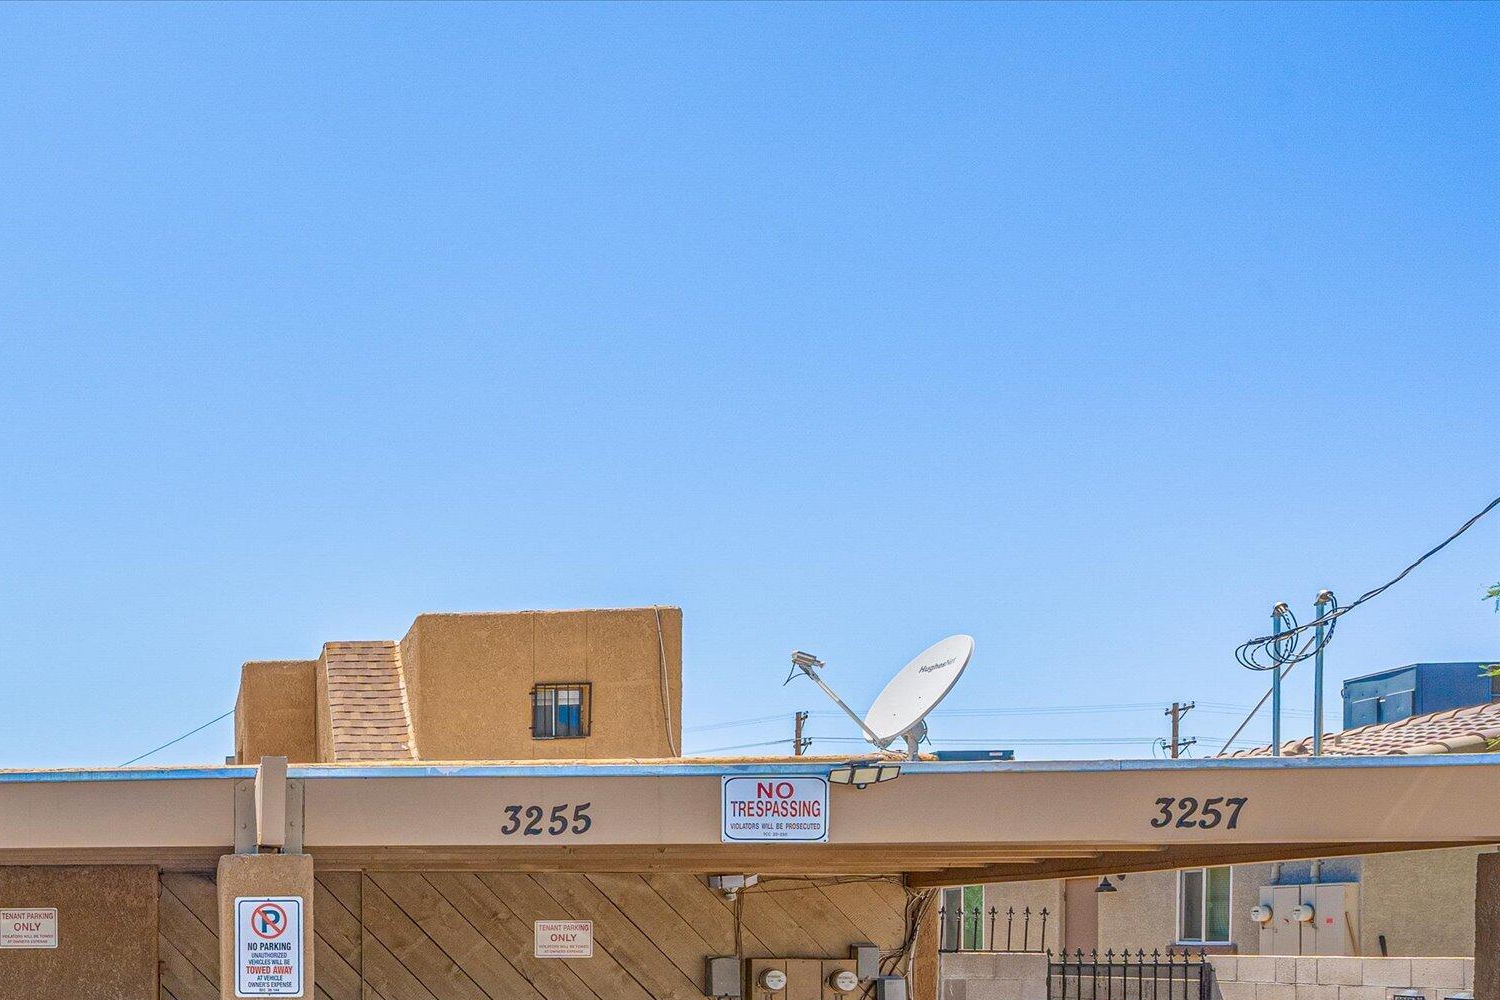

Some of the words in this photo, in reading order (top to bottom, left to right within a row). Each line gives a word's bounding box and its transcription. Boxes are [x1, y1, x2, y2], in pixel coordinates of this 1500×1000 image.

[757, 782, 794, 799] NO
[730, 800, 820, 817] TRESPASSING
[1150, 796, 1248, 830] 3257
[501, 802, 592, 836] 3255
[14, 922, 41, 932] ONLY
[550, 934, 578, 942] ONLY
[248, 942, 258, 950] NO
[260, 942, 292, 950] PARKING
[246, 966, 270, 974] TOWED
[272, 966, 292, 974] AWAY
